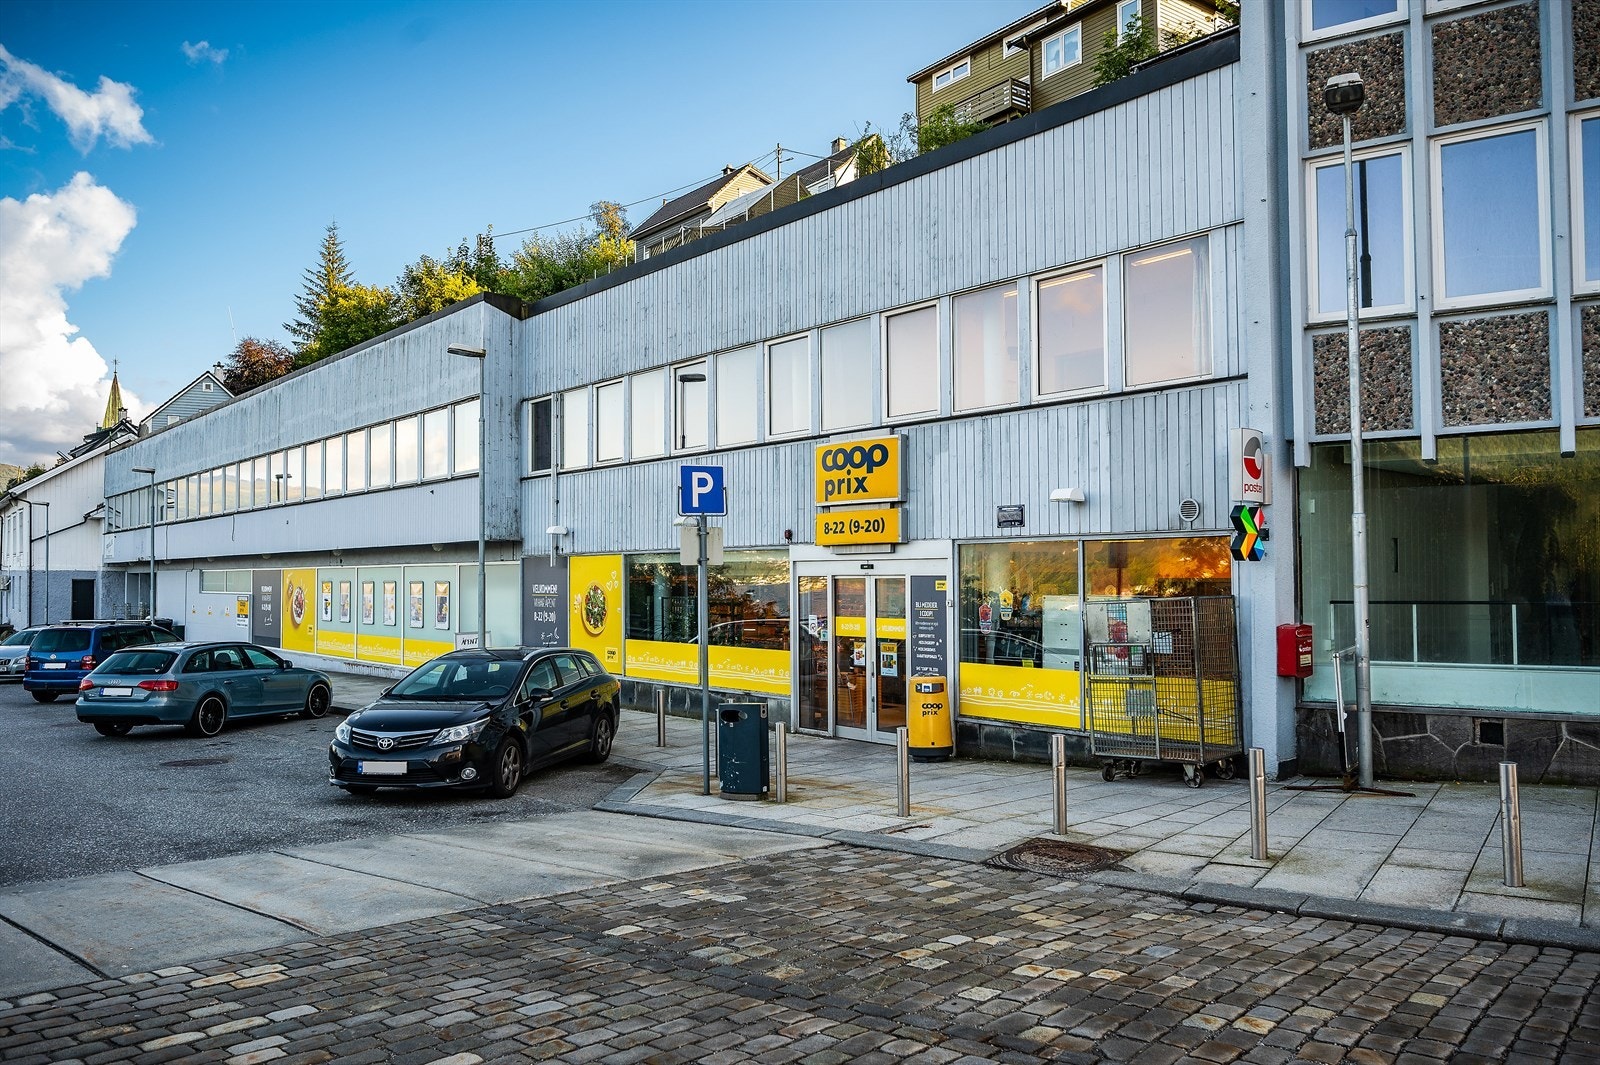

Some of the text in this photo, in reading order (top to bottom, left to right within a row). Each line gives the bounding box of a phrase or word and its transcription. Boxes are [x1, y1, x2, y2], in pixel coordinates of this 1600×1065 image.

[822, 444, 889, 474] coop
[692, 471, 714, 508] P
[825, 469, 869, 502] prix
[1244, 483, 1263, 493] poste
[824, 517, 885, 534] 8-22 (9-20)
[922, 702, 943, 711] coop
[922, 708, 938, 717] prix
